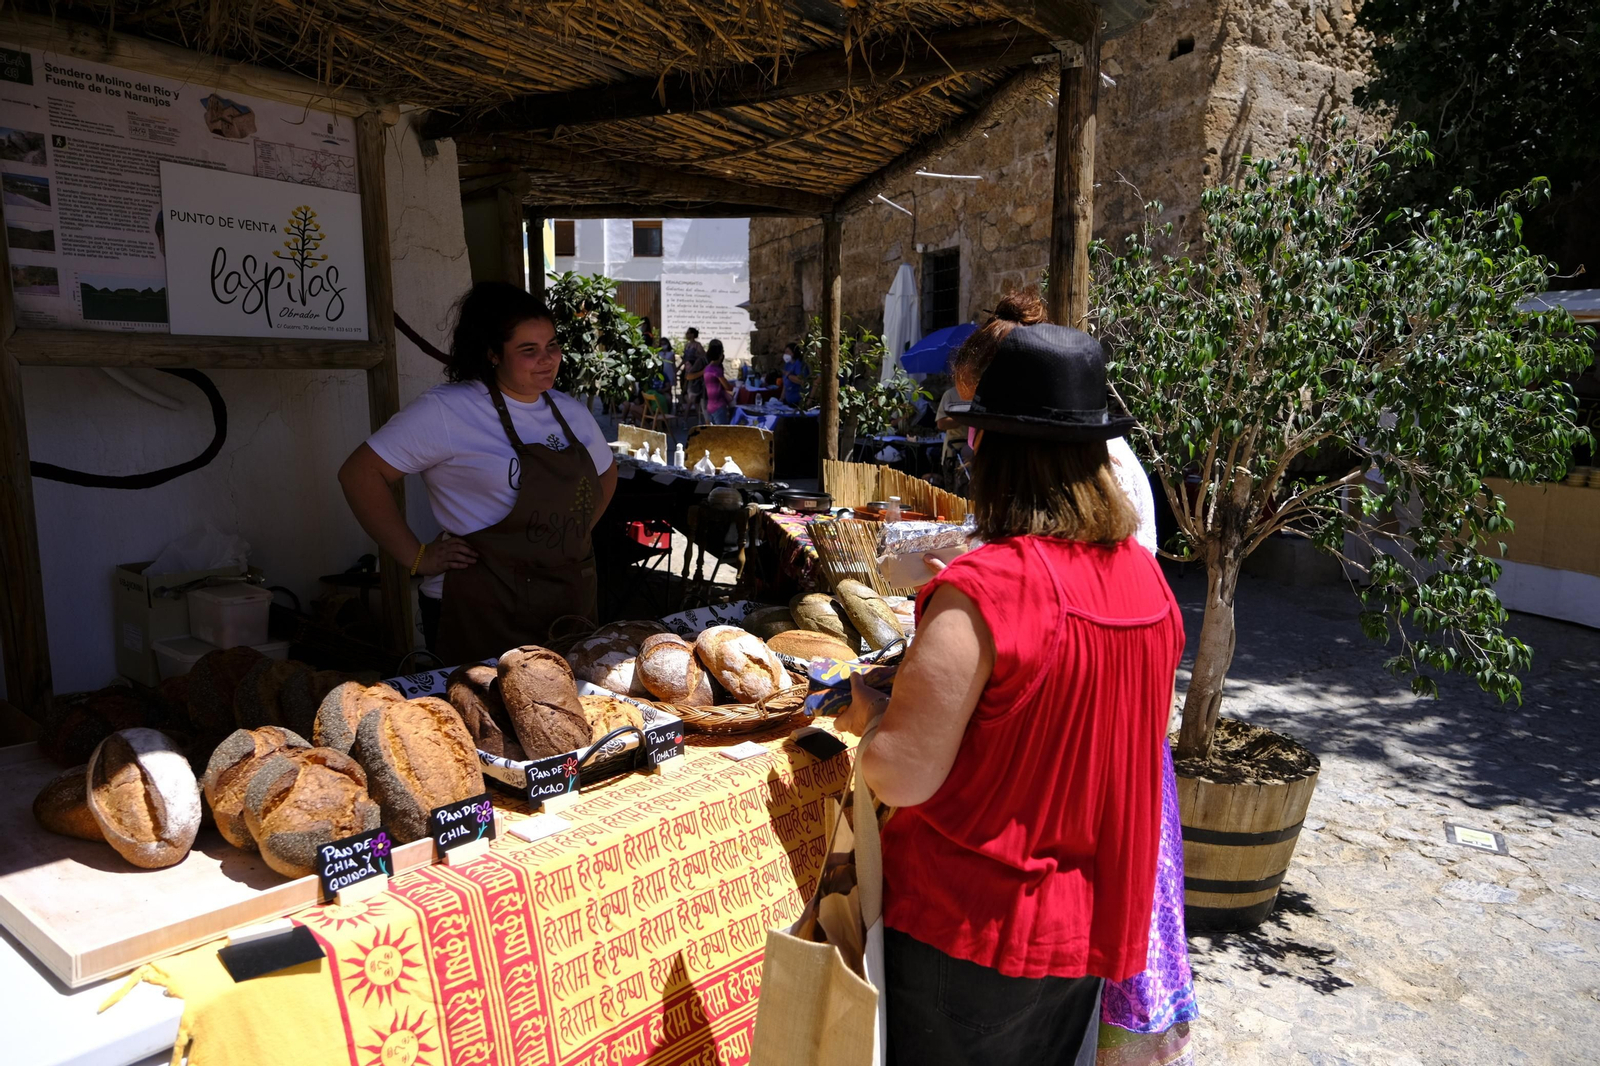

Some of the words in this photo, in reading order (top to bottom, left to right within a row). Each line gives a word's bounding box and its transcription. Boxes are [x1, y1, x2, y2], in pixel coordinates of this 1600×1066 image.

[4, 67, 20, 79] 48
[44, 62, 92, 81] Sendero
[96, 73, 132, 89] Molino
[135, 82, 150, 94] del
[154, 86, 170, 97] Río
[173, 92, 180, 101] y
[45, 74, 85, 90] Fuente
[88, 84, 102, 94] de
[105, 86, 122, 98] los
[124, 90, 171, 108] Naranjos
[170, 210, 215, 226] PUNTO
[218, 216, 234, 229] DE
[238, 219, 278, 234] VENTA
[278, 306, 320, 320] Obrador
[647, 731, 665, 745] PAN
[665, 730, 676, 740] DE
[650, 746, 678, 764] TOMATE
[528, 767, 551, 782] PAN
[552, 764, 563, 776] DE
[531, 782, 565, 798] CACAO
[436, 810, 463, 825] PAN
[461, 803, 478, 816] DE
[438, 824, 471, 846] CHIA
[534, 870, 552, 911] हरे
[548, 864, 577, 903] राम
[576, 853, 595, 892] हरे
[623, 833, 641, 870] हरे
[636, 826, 660, 862] राम
[658, 817, 677, 852] हरे
[698, 800, 716, 835] हरे
[710, 800, 731, 831] राम
[728, 792, 747, 826] हरे
[758, 780, 774, 811] हरे
[768, 778, 787, 807] राम
[780, 769, 796, 800] हरे
[812, 759, 826, 788] हरे
[322, 845, 354, 862] PAN
[353, 838, 373, 853] DE
[324, 858, 358, 877] CHIA
[362, 852, 372, 864] Y
[482, 871, 518, 896] राम
[544, 916, 562, 956] हरे
[557, 908, 584, 948] राम
[586, 898, 603, 935] हरे
[632, 875, 649, 912] हरे
[645, 867, 669, 903] राम
[668, 858, 687, 893] हरे
[710, 840, 728, 874] हरे
[720, 837, 744, 869] राम
[738, 830, 756, 862] हरे
[770, 814, 783, 846] हरे
[777, 812, 796, 842] राम
[790, 804, 804, 835] हरे
[418, 890, 462, 918] राम
[491, 891, 526, 921] हरे
[433, 914, 470, 943] हरे
[552, 962, 570, 1002] हरे
[565, 952, 590, 993] राम
[592, 940, 611, 980] हरे
[639, 917, 658, 954] हरे
[652, 908, 677, 945] राम
[676, 898, 694, 934] हरे
[718, 880, 737, 914] हरे
[730, 874, 752, 908] राम
[749, 866, 767, 900] हरे
[779, 852, 793, 883] हरे
[800, 840, 814, 871] हरे
[504, 960, 538, 992] हरे
[559, 1006, 577, 1046] हरे
[572, 996, 598, 1036] राम
[600, 985, 618, 1022] हरे
[648, 958, 668, 994] हरे
[662, 948, 688, 989] राम
[686, 938, 704, 972] हरे
[728, 918, 748, 953] हरे
[738, 912, 764, 947] राम
[447, 988, 485, 1020] हरे
[507, 982, 541, 1022] राम
[649, 1013, 669, 1048] हरे
[666, 999, 691, 1039] राम
[690, 989, 709, 1024] हरे
[706, 980, 729, 1018] राम
[728, 972, 746, 1004] हरे
[449, 1009, 488, 1050] राम
[515, 1014, 548, 1048] हरे
